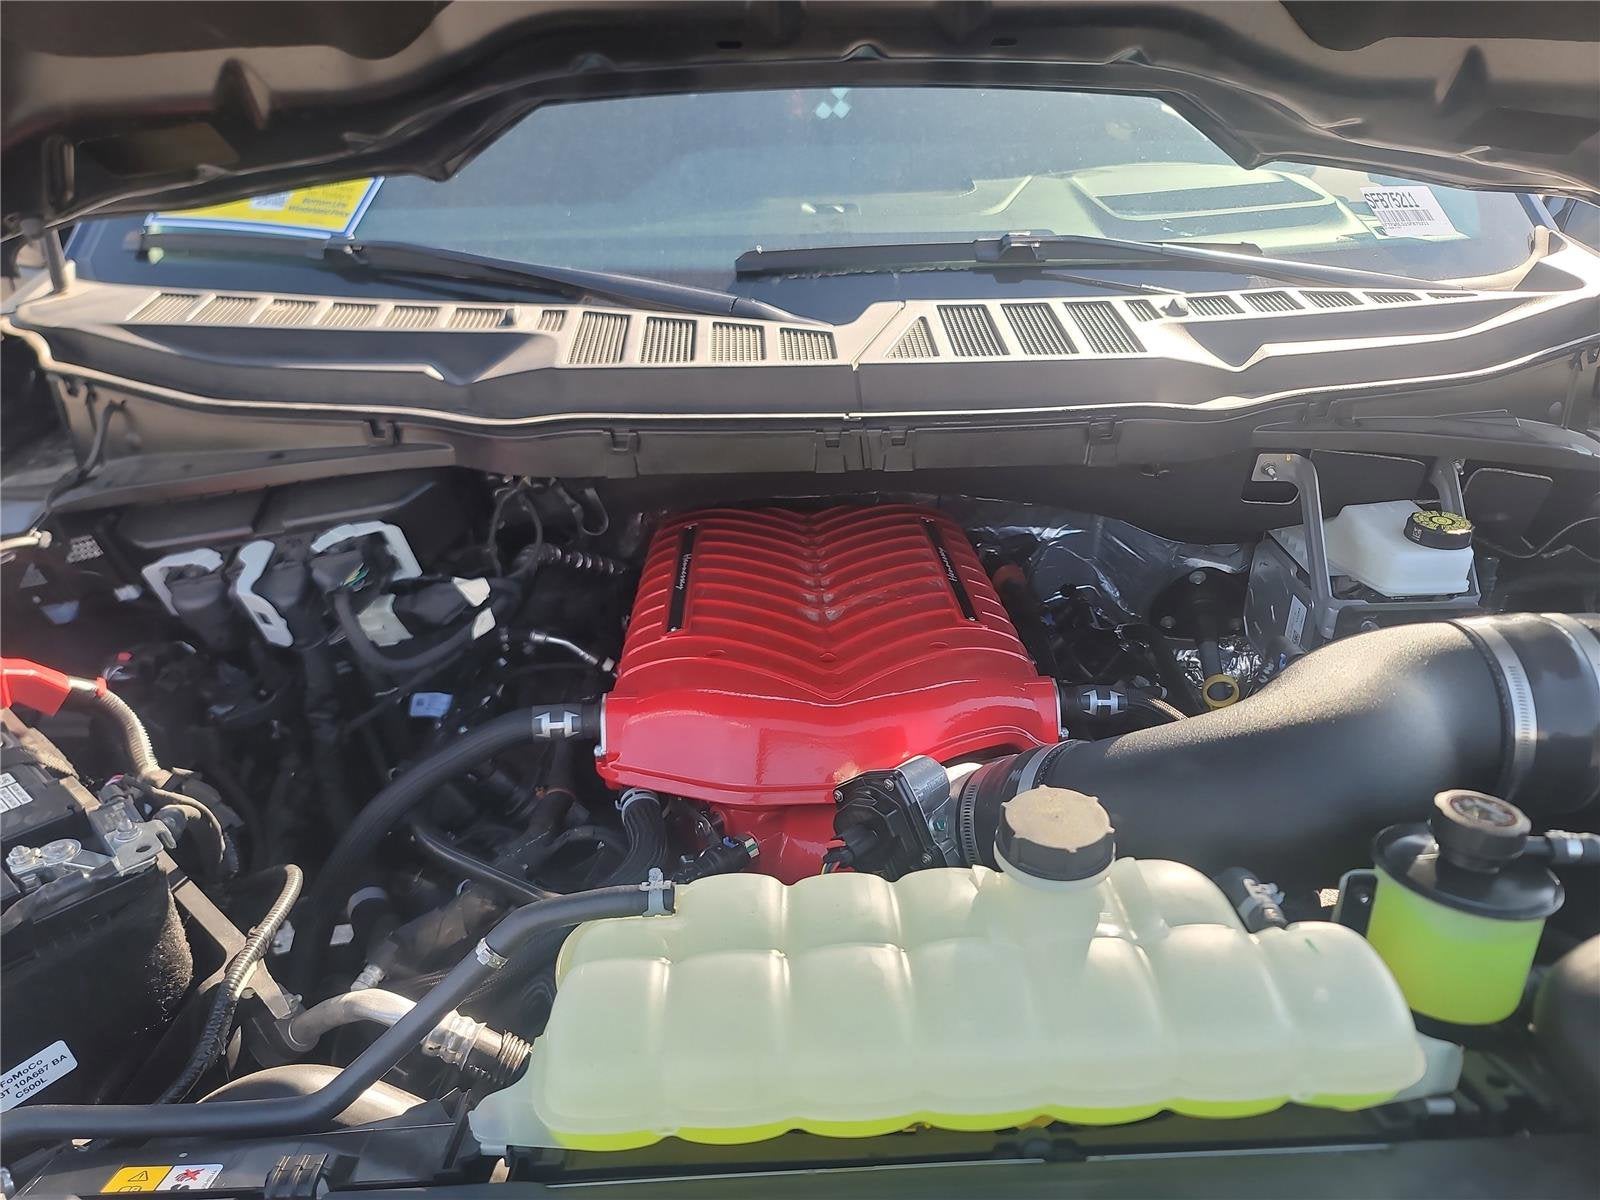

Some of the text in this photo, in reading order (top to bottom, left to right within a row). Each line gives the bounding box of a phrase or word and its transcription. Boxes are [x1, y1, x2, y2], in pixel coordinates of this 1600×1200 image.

[1364, 191, 1420, 209] SFB75211
[0, 1059, 43, 1088] FoMoCo
[14, 1064, 49, 1089] 10A687
[51, 1054, 67, 1066] BA
[15, 1077, 47, 1099] C500L
